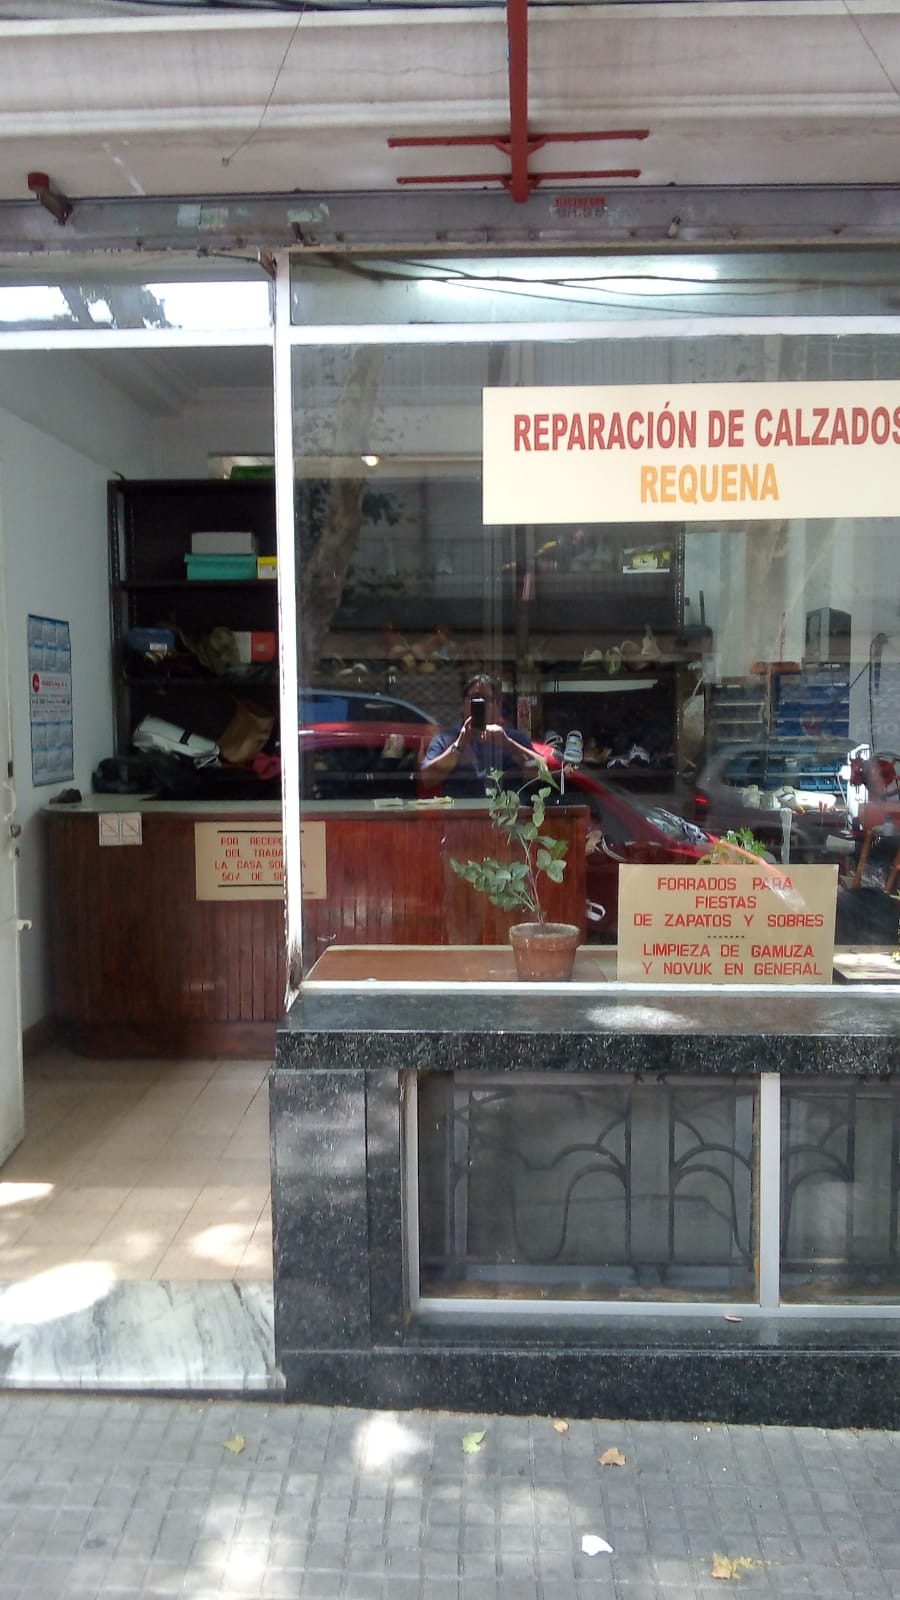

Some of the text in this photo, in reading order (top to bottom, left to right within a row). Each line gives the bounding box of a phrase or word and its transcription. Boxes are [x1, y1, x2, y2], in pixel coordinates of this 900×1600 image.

[513, 401, 697, 452] REPARACIÓN
[708, 408, 745, 448] DE
[640, 463, 780, 505] REQUENA
[220, 836, 239, 846] POR
[225, 848, 283, 858] DEL TRABA
[214, 860, 228, 870] LA
[236, 860, 263, 870] CASA
[251, 872, 263, 881] DE
[657, 877, 793, 891] FORRADOS PARA
[695, 896, 757, 909] FIESTAS
[633, 914, 824, 928] DE ZAPATOS Y SOBRES
[643, 943, 815, 958] LIMPIEZA DE GAMUZA
[641, 961, 823, 976] Y NOVUK EN GENERAL
